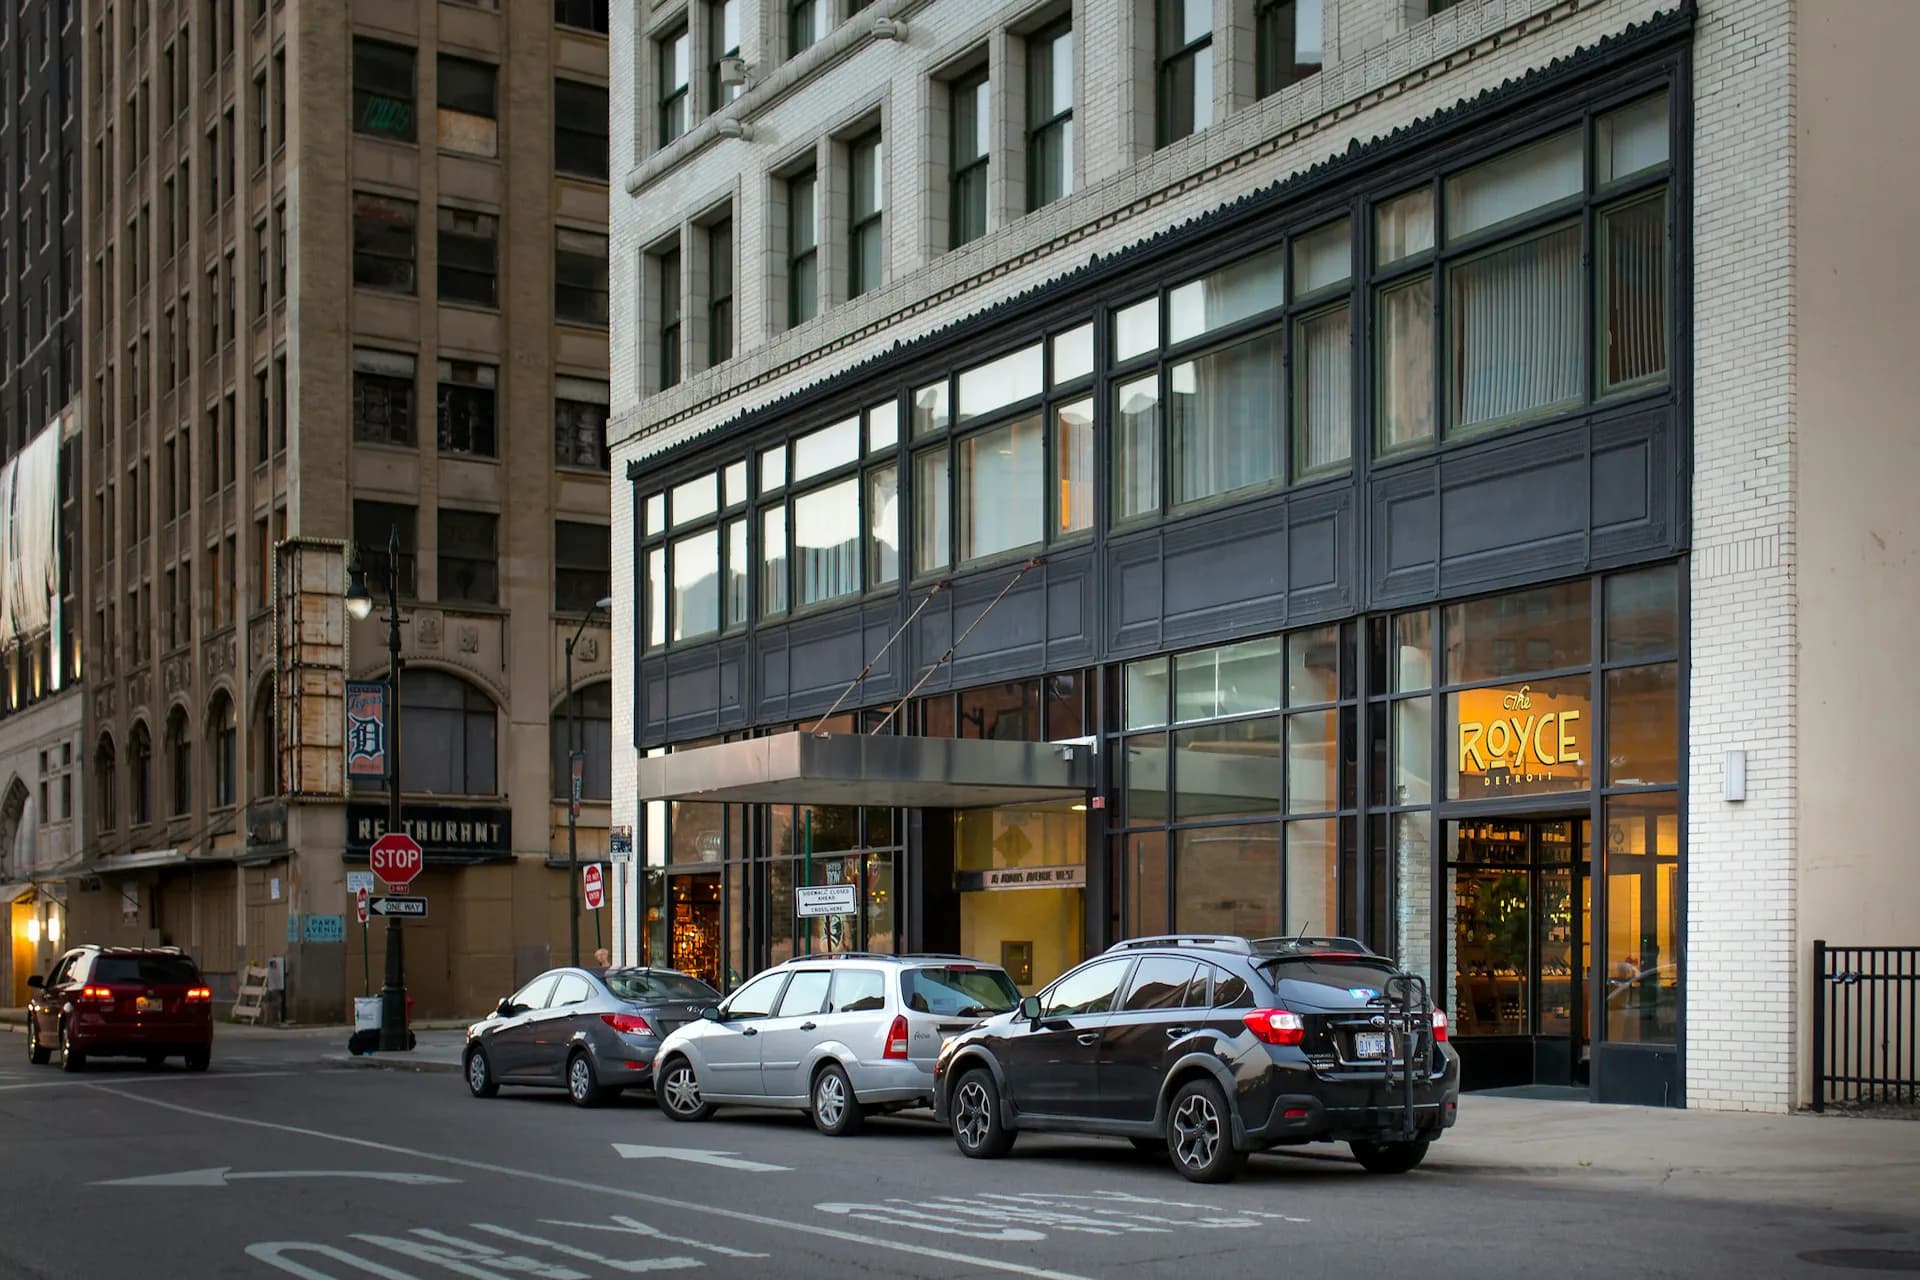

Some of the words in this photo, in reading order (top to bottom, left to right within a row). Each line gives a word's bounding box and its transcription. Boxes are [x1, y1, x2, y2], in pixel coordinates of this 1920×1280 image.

[1503, 684, 1532, 711] The
[348, 712, 384, 763] D
[1459, 710, 1580, 772] ROYCE
[1484, 771, 1553, 786] DETROIT
[358, 817, 501, 844] RETAURANT
[374, 849, 419, 869] STOP
[1026, 871, 1051, 882] AVENUE
[1055, 870, 1075, 880] WEST
[386, 902, 401, 913] ONE
[404, 902, 421, 913] WAY
[305, 926, 342, 934] AVENUE
